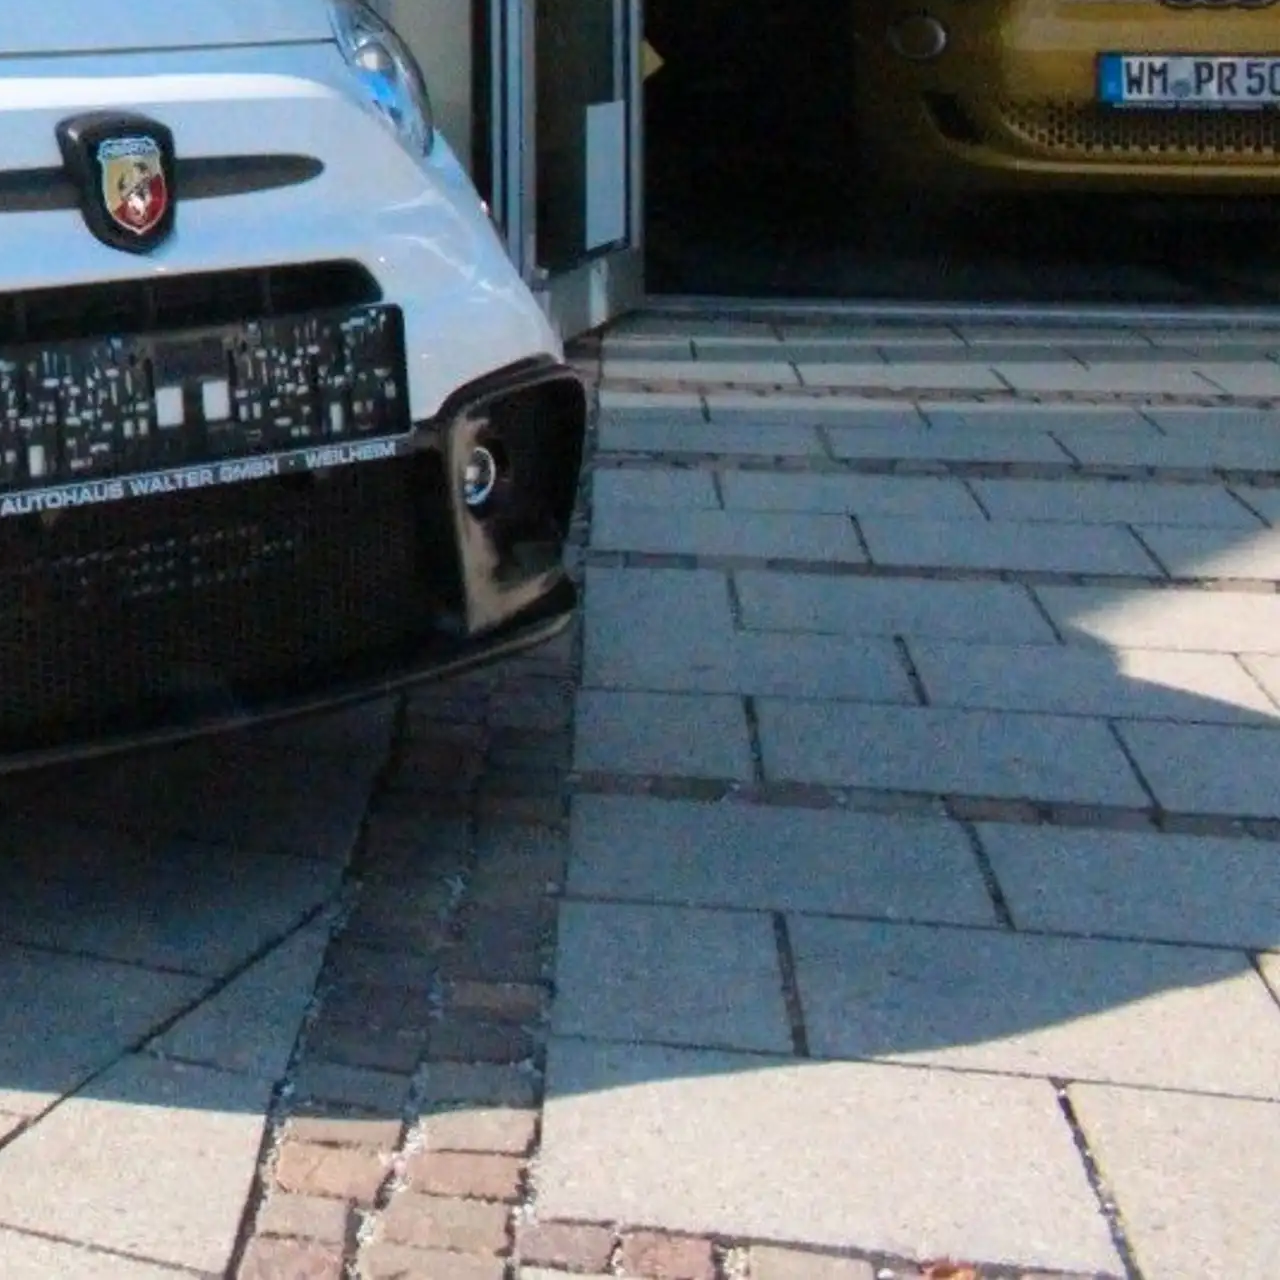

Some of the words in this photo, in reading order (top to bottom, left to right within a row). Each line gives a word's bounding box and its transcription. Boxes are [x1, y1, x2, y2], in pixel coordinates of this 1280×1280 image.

[1125, 61, 1169, 95] WM
[1193, 61, 1237, 96] PR
[0, 481, 124, 516] AUTOHAUS
[129, 468, 215, 497] WALTER
[305, 440, 397, 469] WEILHEIM
